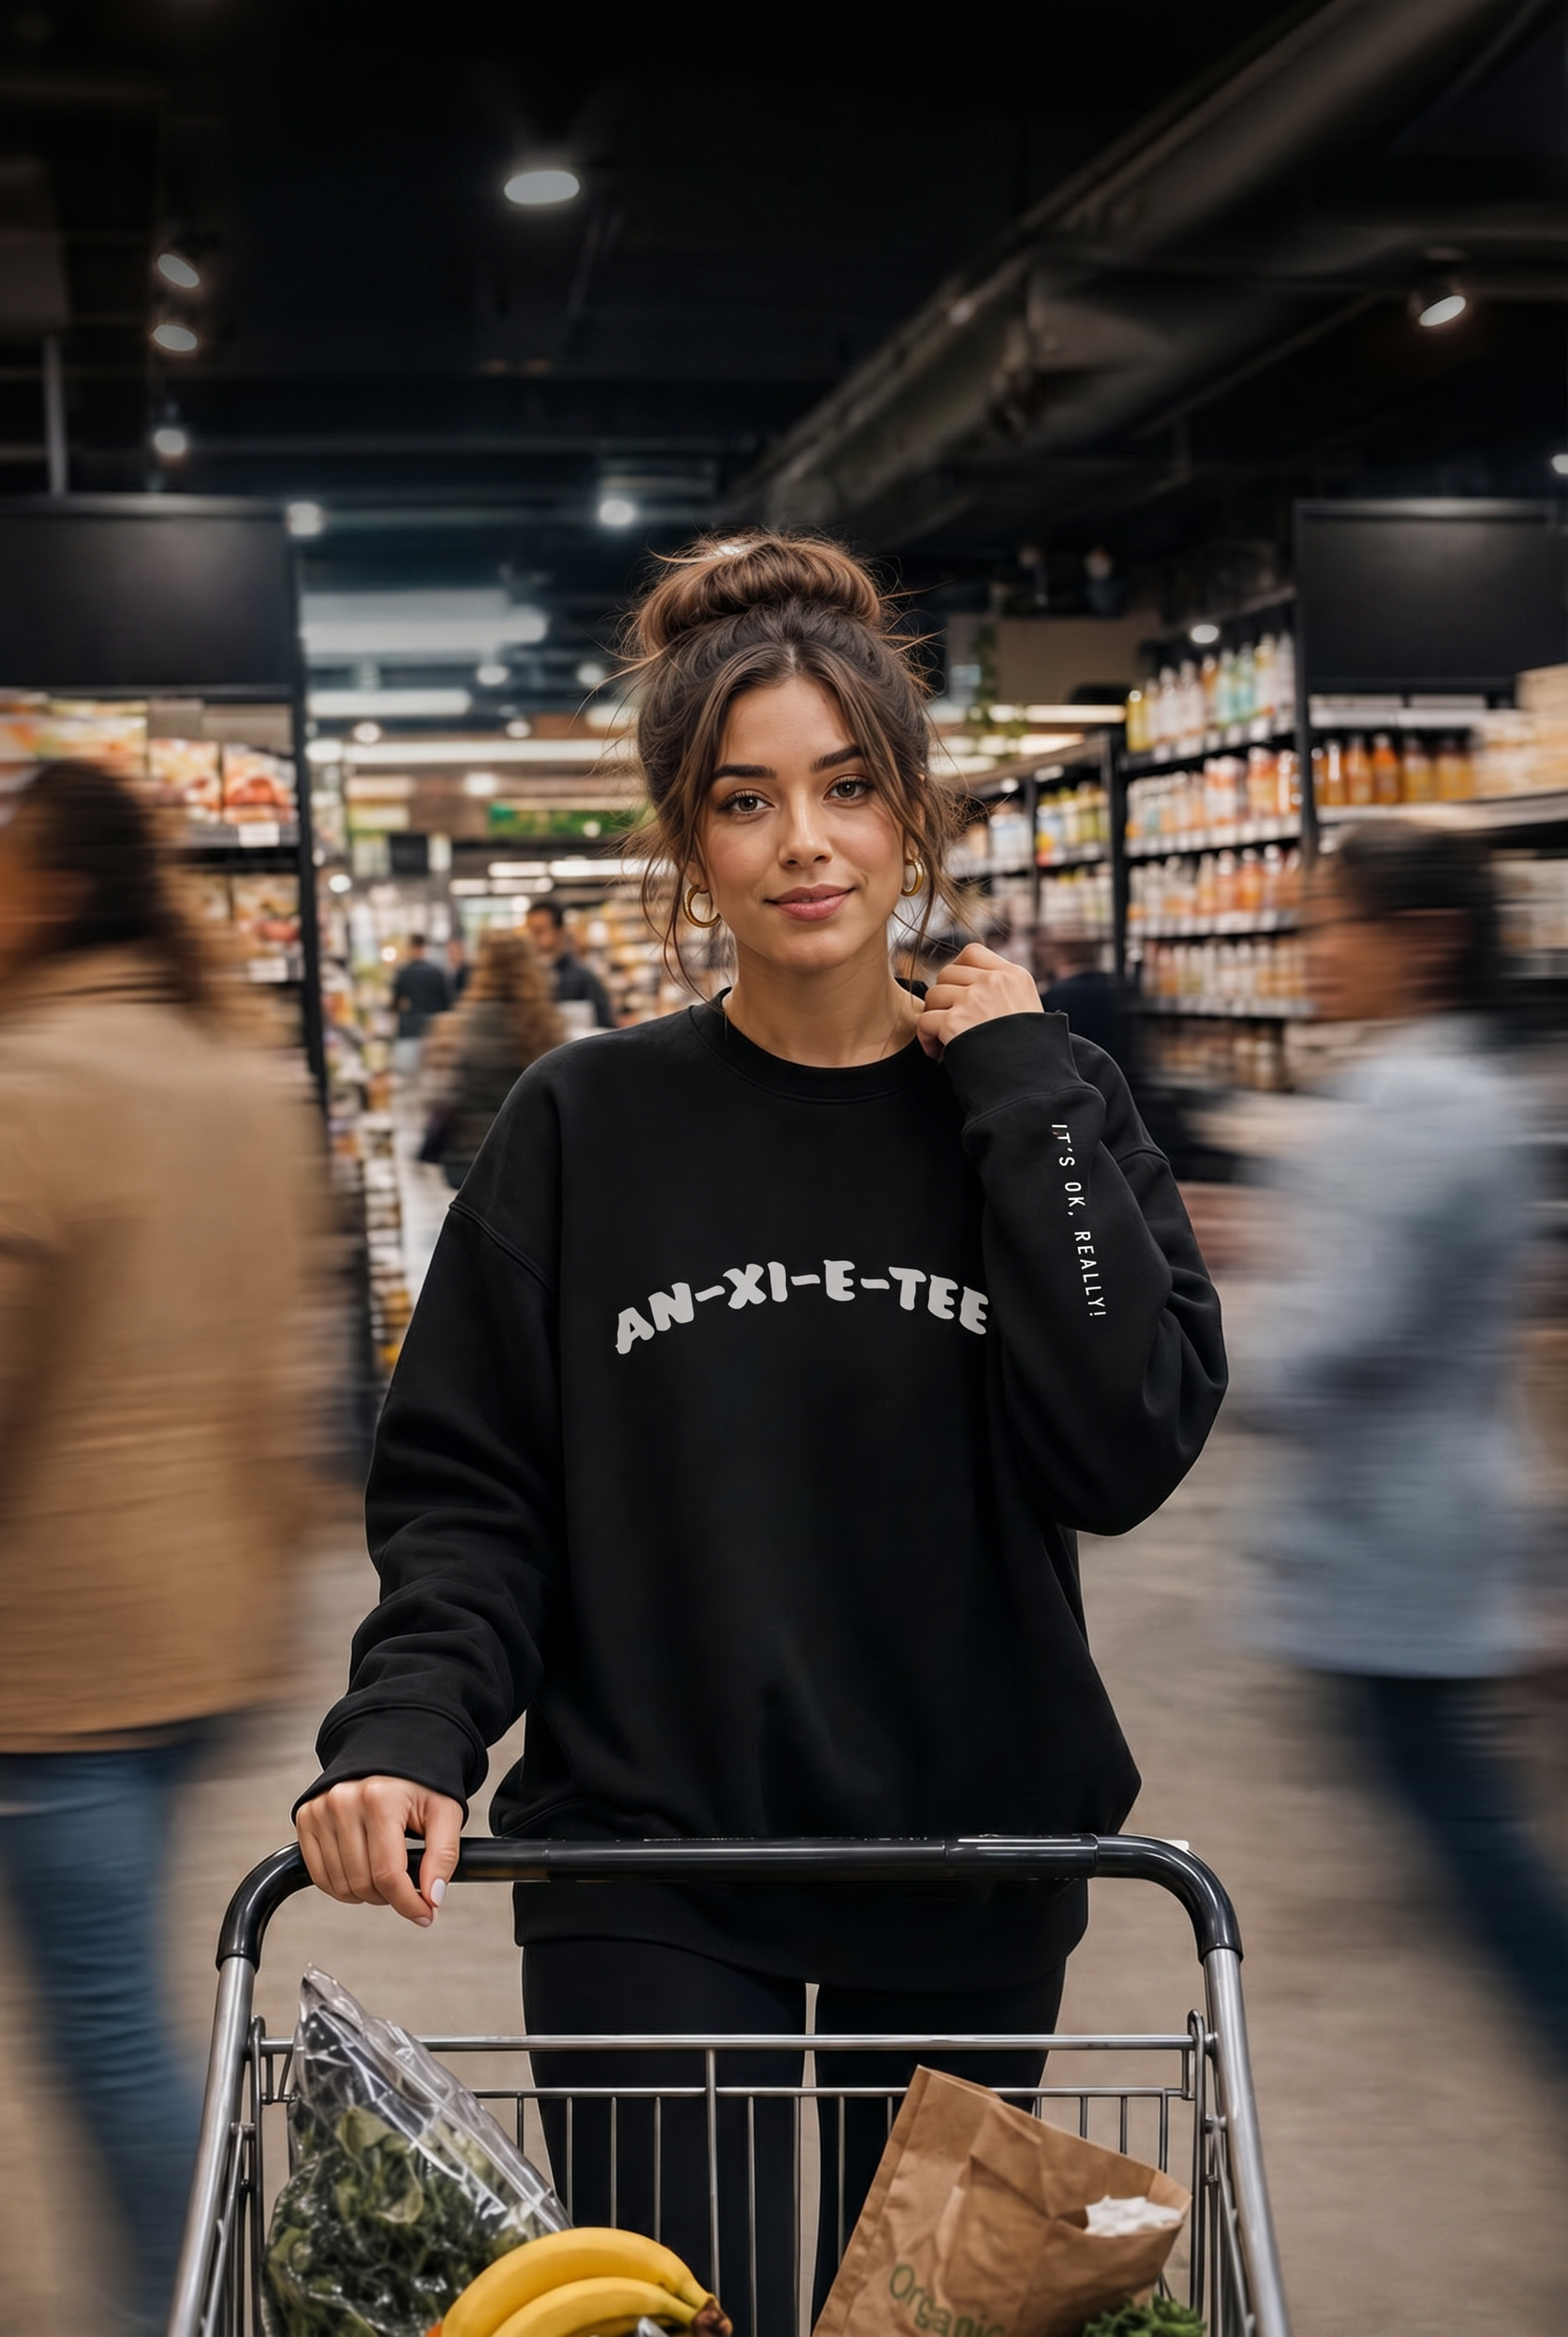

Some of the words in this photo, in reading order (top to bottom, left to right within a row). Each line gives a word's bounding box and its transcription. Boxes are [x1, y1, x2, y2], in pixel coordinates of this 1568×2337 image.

[1064, 1181, 1086, 1217] OK,
[615, 1259, 989, 1356] AN-XI-E-TEE
[1073, 1230, 1107, 1316] REALLY!
